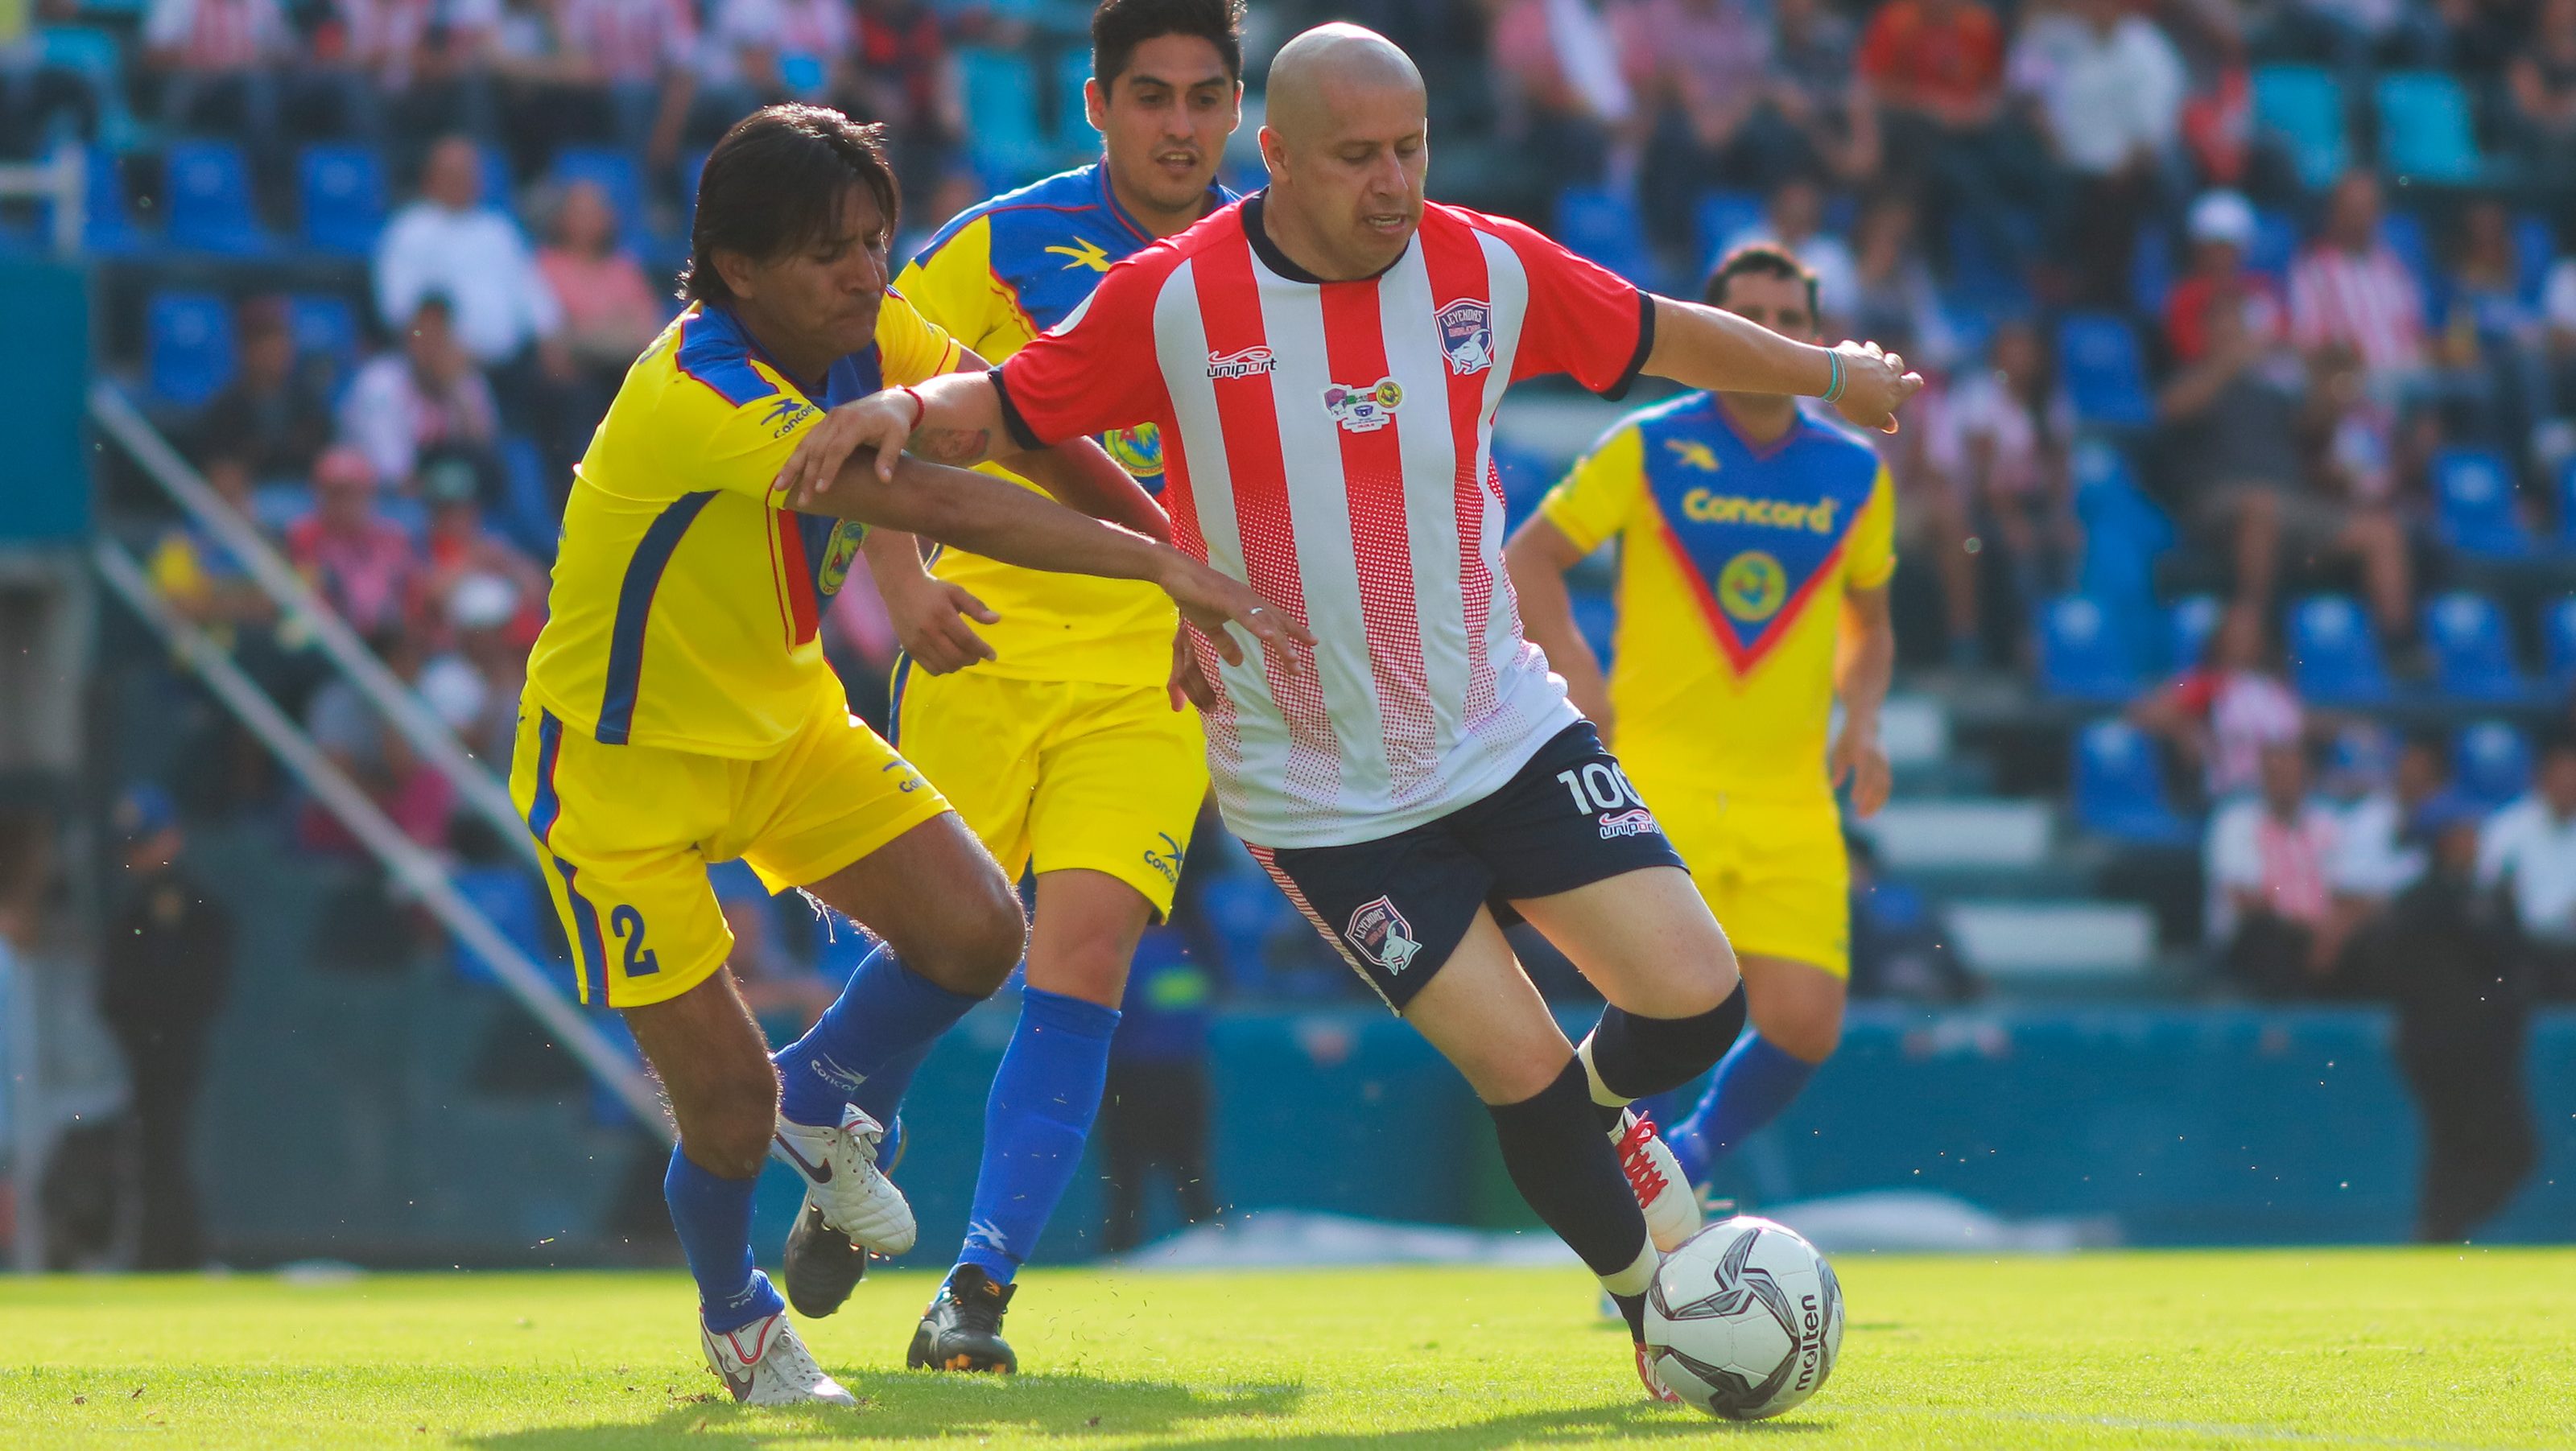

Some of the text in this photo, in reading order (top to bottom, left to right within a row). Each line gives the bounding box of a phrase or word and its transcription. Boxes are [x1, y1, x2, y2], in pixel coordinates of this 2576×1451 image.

[1442, 308, 1484, 328] LEYENDAS
[1207, 358, 1278, 377] uniport
[1682, 488, 1834, 536] Concord
[611, 904, 660, 978] 2
[1354, 908, 1386, 940] LEYENDAS
[1794, 1294, 1819, 1391] molten
